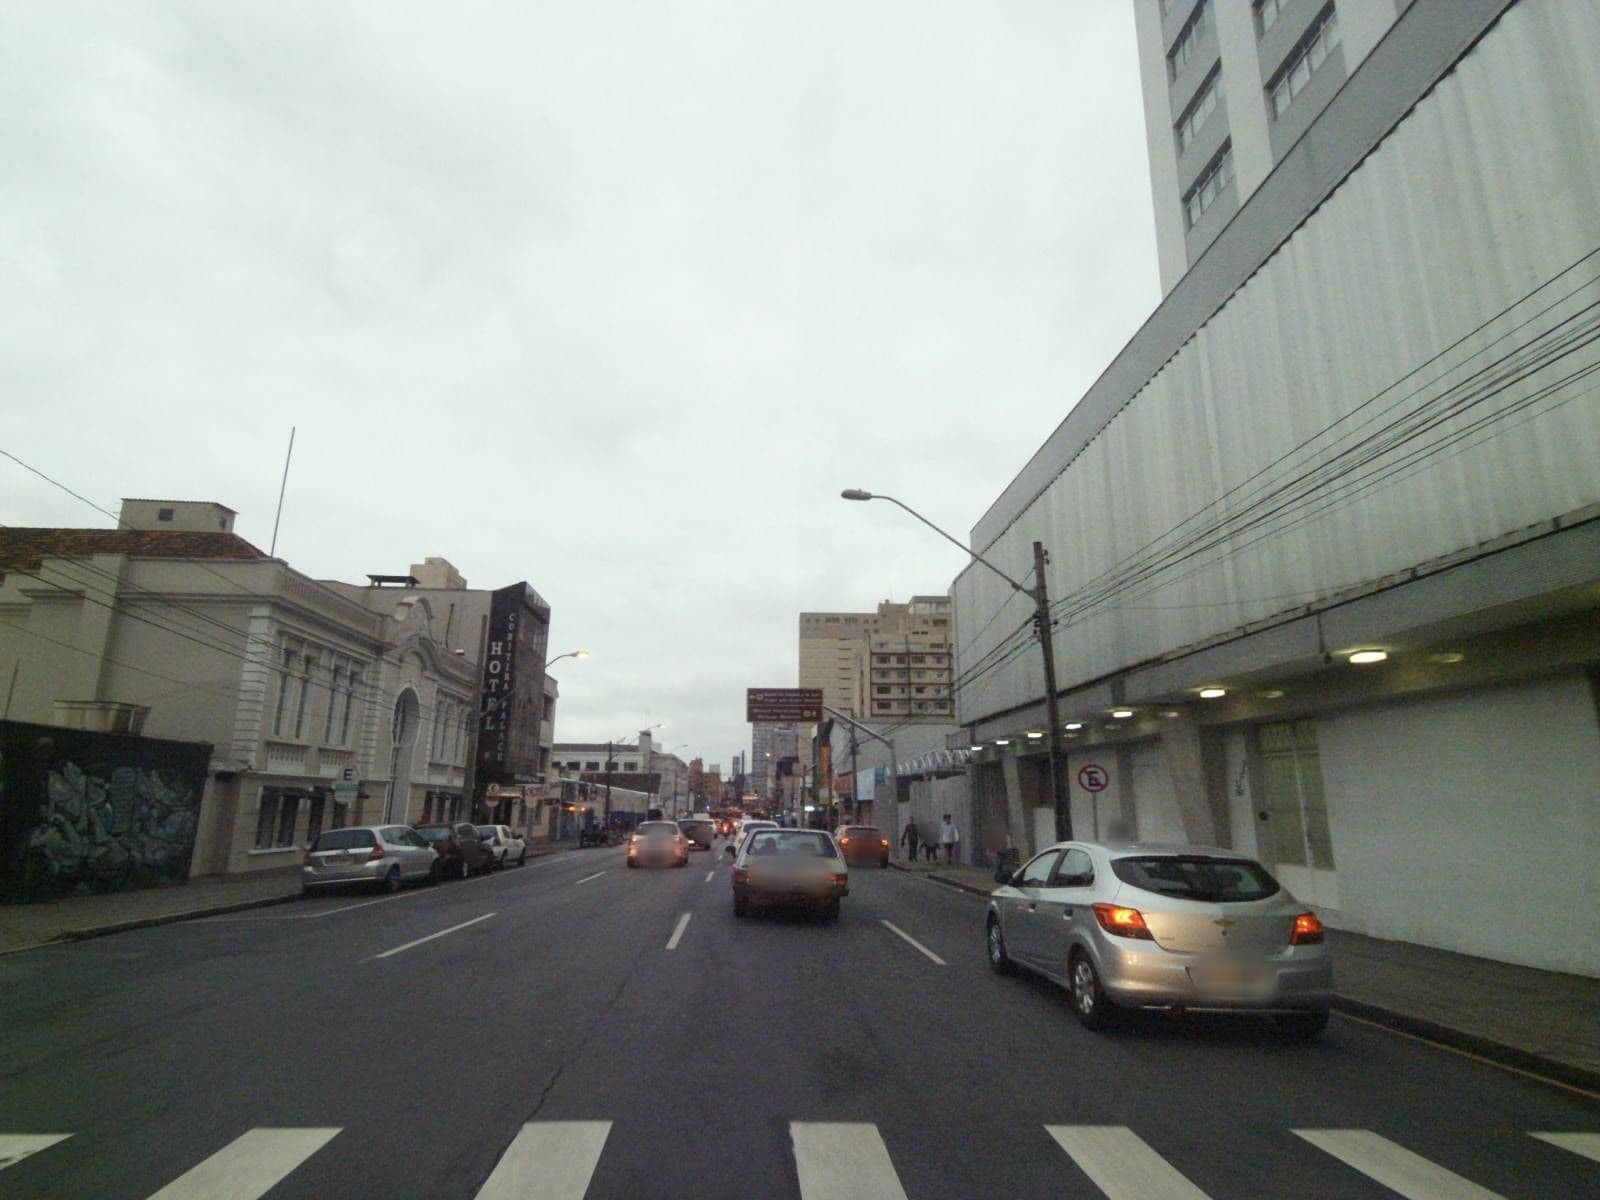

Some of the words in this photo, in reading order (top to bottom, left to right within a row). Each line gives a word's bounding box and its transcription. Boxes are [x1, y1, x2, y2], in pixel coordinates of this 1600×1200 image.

[485, 639, 504, 730] HOTEL
[343, 768, 353, 780] E
[1087, 770, 1100, 787] E
